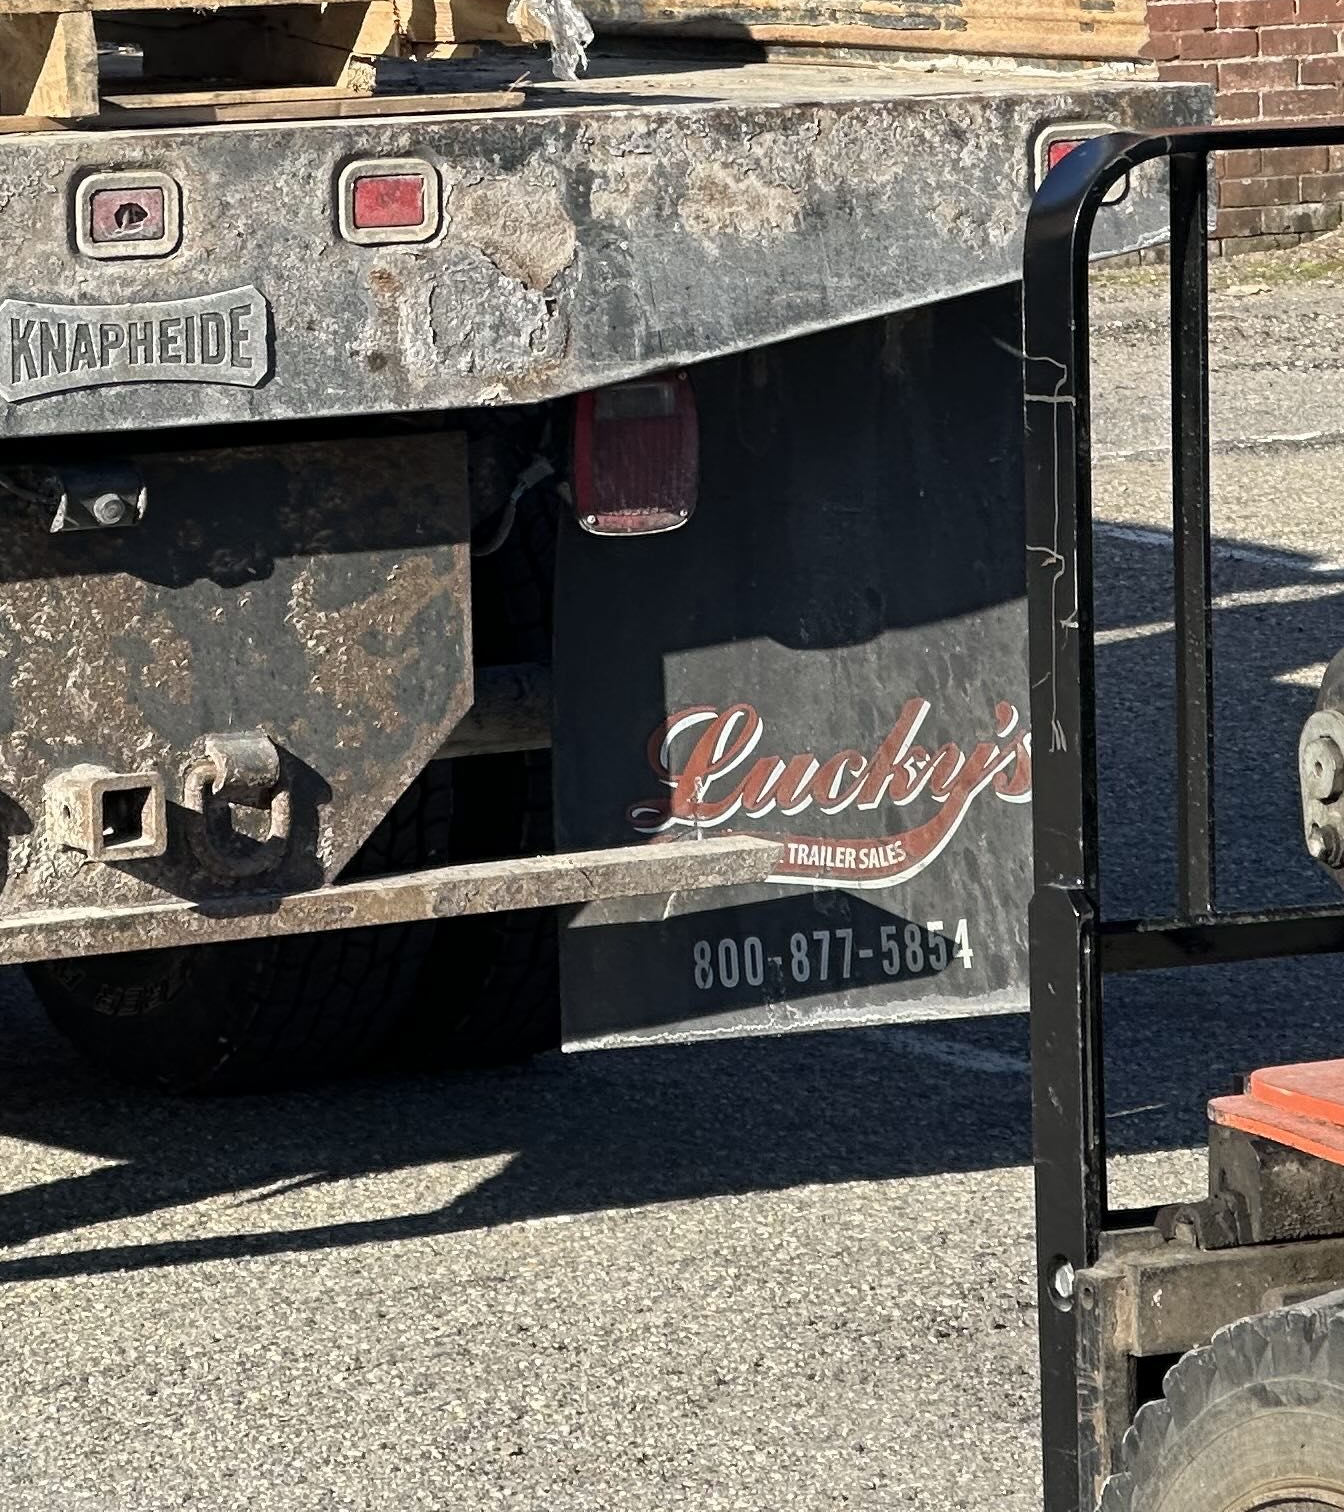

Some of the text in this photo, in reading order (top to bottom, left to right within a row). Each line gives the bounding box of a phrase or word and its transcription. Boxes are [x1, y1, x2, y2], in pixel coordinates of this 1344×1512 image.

[9, 303, 254, 385] KNAPHEIDE
[625, 696, 1032, 834] Lucky's
[788, 840, 907, 870] TRAILER SALES
[692, 918, 974, 989] 800-877-5854
